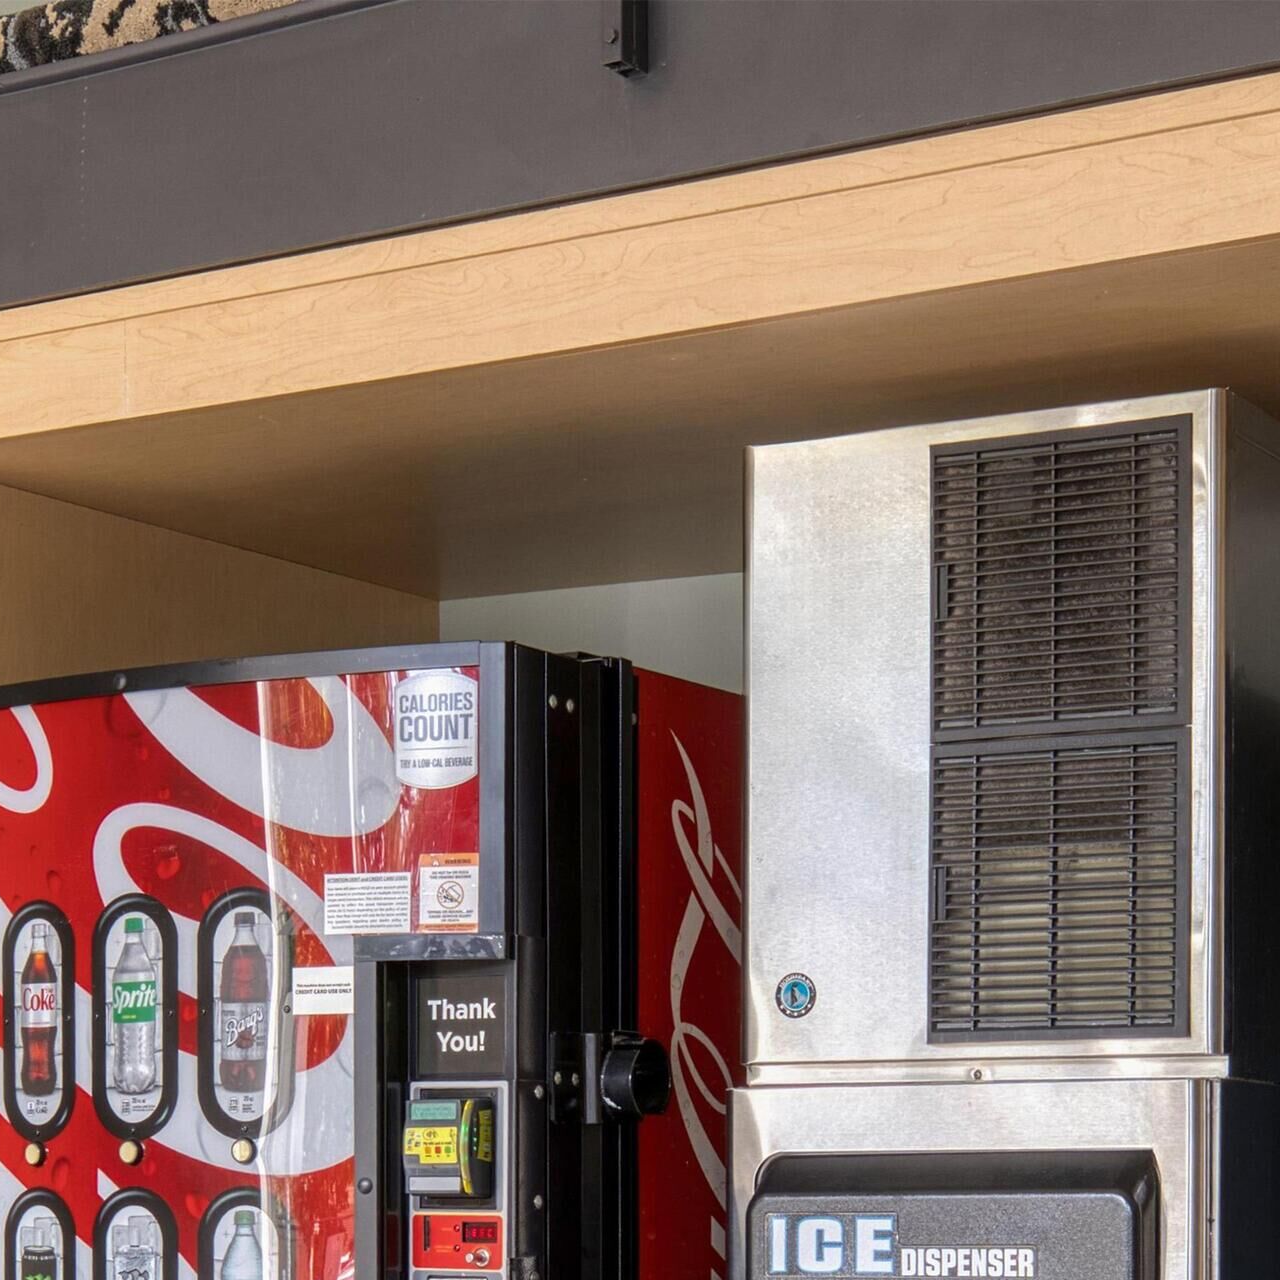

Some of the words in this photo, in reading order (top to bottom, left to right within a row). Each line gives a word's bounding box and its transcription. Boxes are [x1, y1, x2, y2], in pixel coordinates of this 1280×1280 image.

[399, 691, 474, 713] CALORIES
[399, 712, 474, 743] COUNT
[444, 756, 473, 767] BEVERAGE
[23, 987, 55, 1012] Coke
[113, 983, 157, 1014] Sprite
[427, 997, 497, 1021] Thank
[225, 1007, 265, 1047] Barq's
[436, 1030, 486, 1053] You!
[769, 1216, 894, 1274] ICE
[900, 1247, 1035, 1278] DISPENSER
